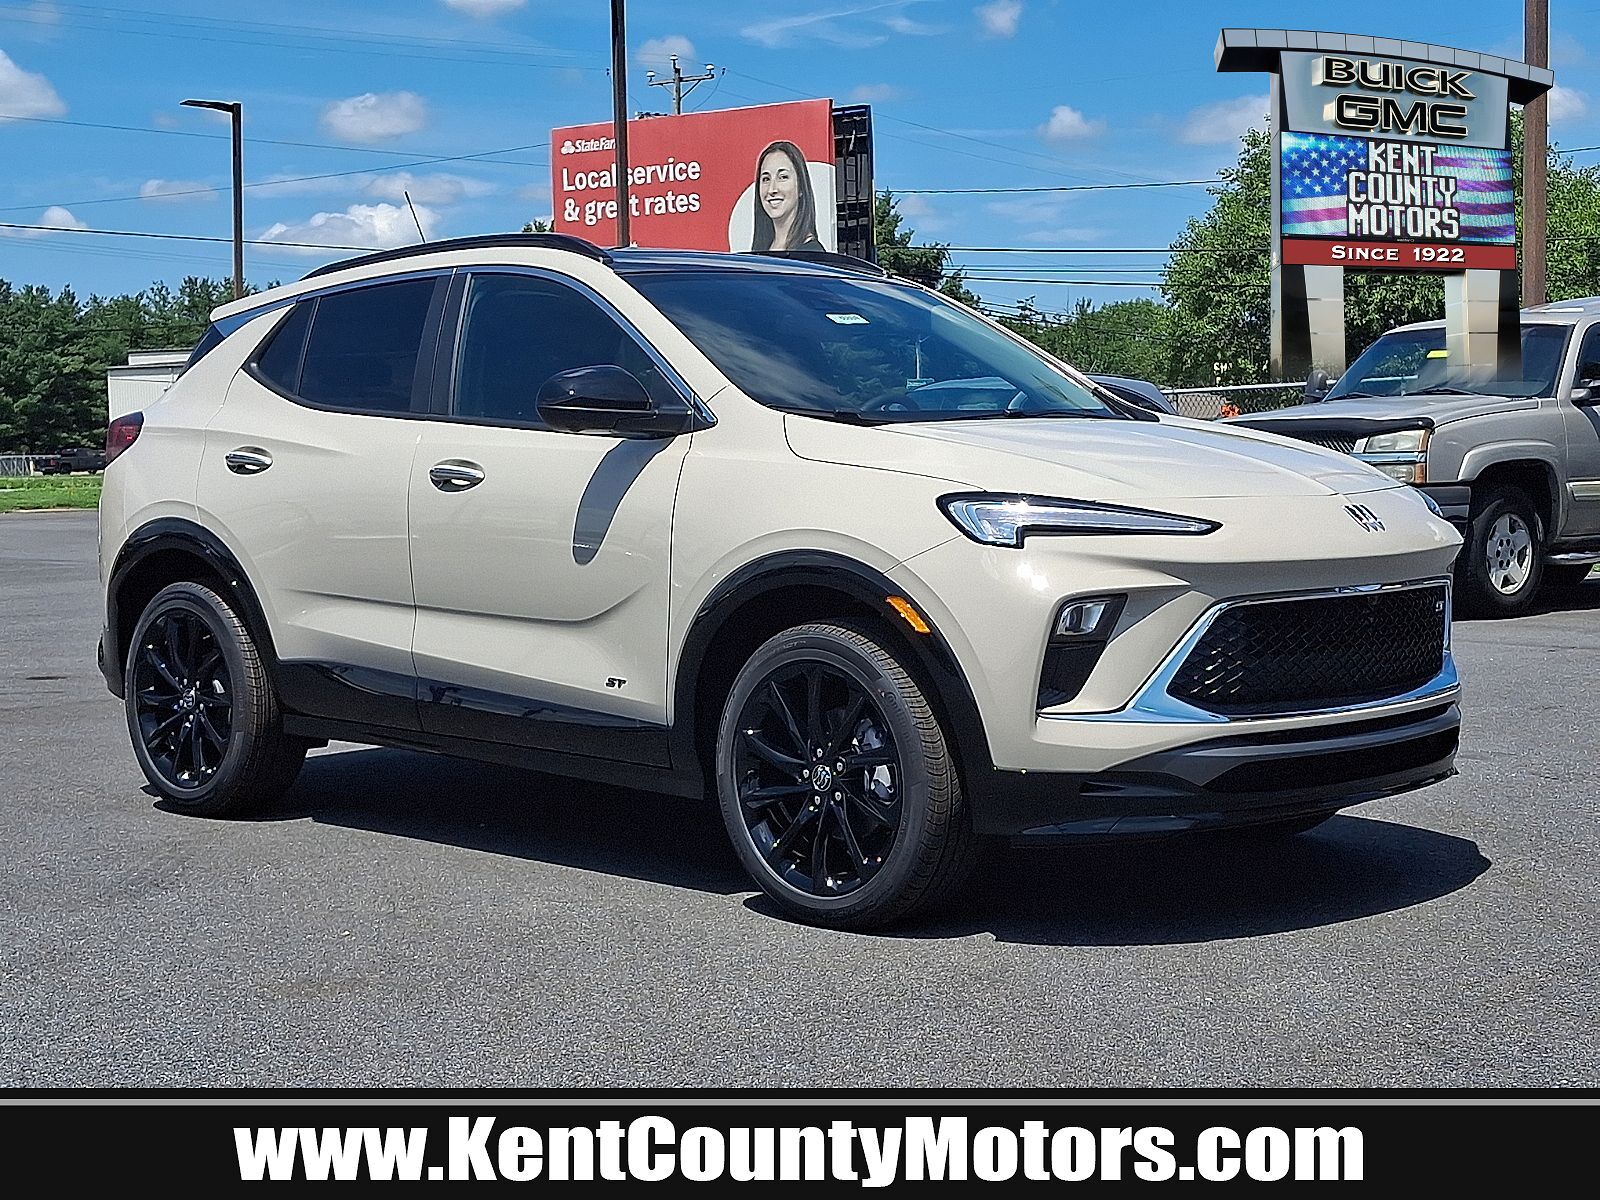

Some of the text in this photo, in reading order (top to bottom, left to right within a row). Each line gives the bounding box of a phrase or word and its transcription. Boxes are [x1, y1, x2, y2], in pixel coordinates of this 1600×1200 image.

[1322, 54, 1477, 99] BUICK
[1334, 93, 1469, 137] GMC
[1368, 141, 1437, 176] KENT
[562, 162, 617, 191] Local
[1349, 171, 1457, 206] COUNTY
[564, 190, 701, 226] & gret rates
[1348, 203, 1459, 239] MOTORS
[1413, 247, 1465, 263] 1922
[605, 677, 627, 689] ST
